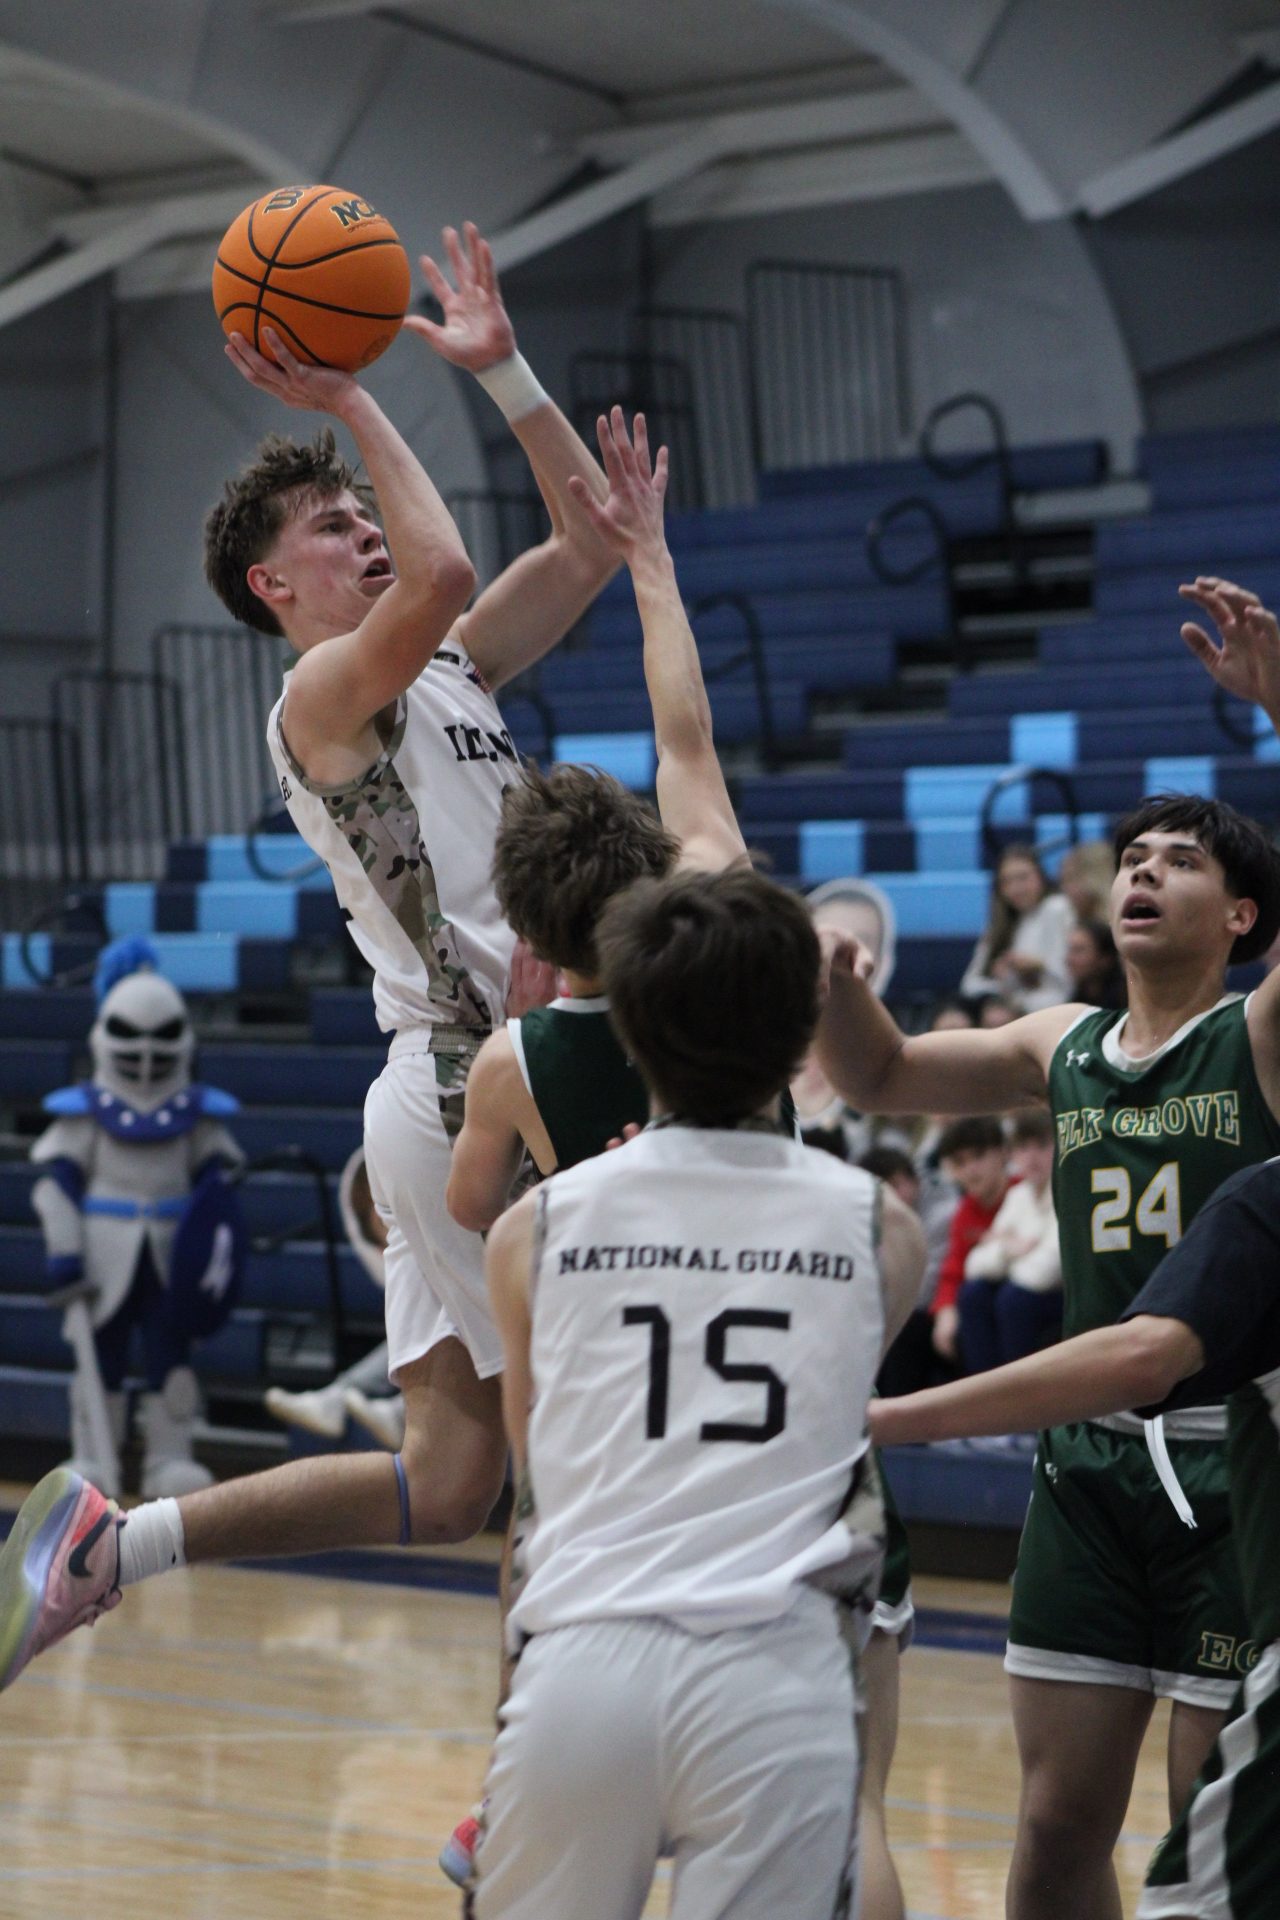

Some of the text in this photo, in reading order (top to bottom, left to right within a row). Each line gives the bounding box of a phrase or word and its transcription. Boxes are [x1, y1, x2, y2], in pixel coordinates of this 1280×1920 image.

[1112, 1090, 1240, 1146] GROVE
[1091, 1161, 1182, 1253] 24
[559, 1246, 855, 1281] NATIONAL GUARD
[622, 1305, 791, 1443] 15
